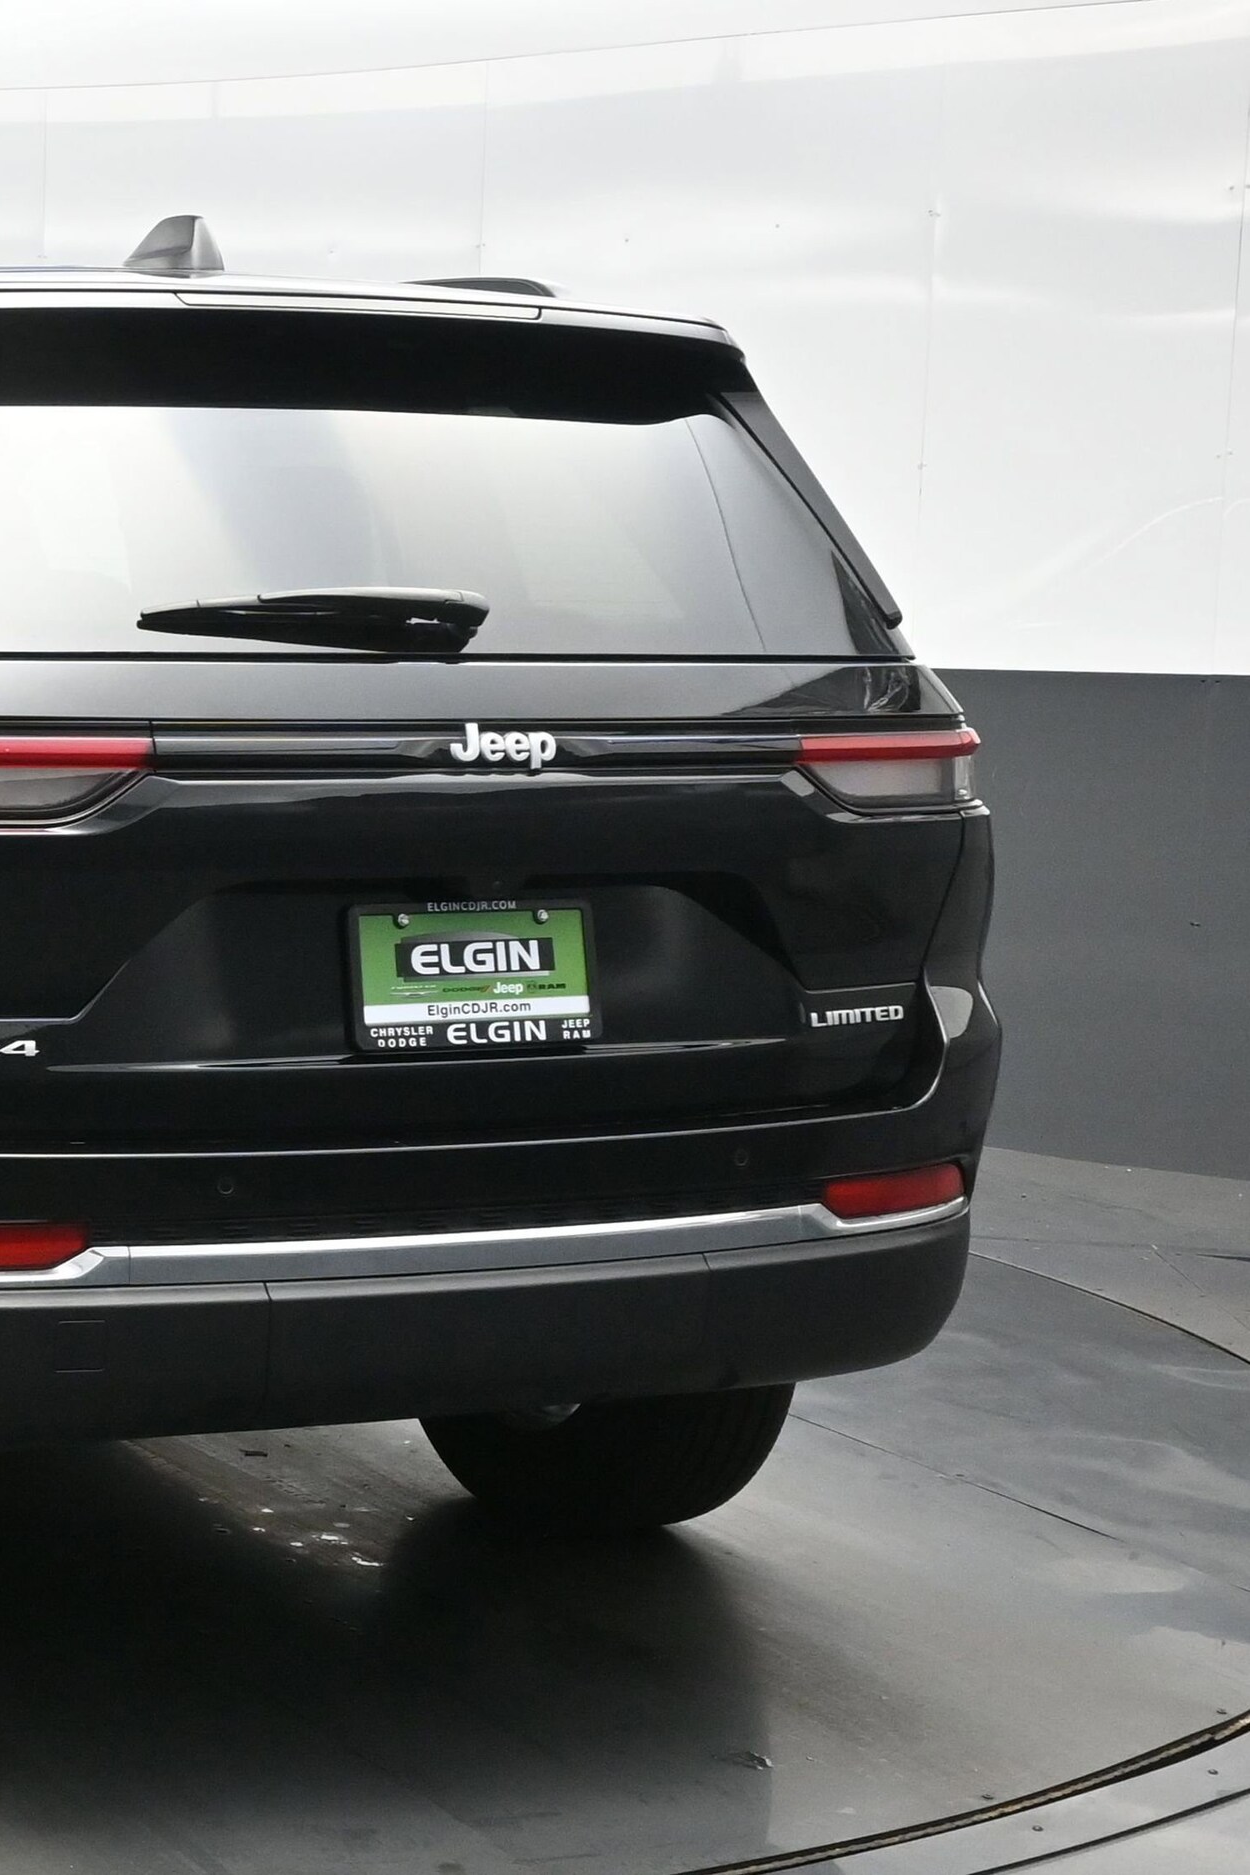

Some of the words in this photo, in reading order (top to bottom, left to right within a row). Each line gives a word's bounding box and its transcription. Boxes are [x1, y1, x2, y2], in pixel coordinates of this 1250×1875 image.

[450, 722, 556, 770] Jeep
[427, 900, 517, 912] ELGINCDJR.COM
[410, 940, 541, 975] ELGIN
[493, 982, 524, 995] Jeep
[427, 1002, 532, 1018] ElginCDJR.com
[810, 1005, 904, 1028] LIMITED
[561, 1018, 591, 1029] JEEP
[370, 1026, 434, 1038] CHRYSLER
[447, 1020, 547, 1045] ELGIN
[563, 1029, 591, 1040] RAM
[377, 1037, 427, 1048] DODGE
